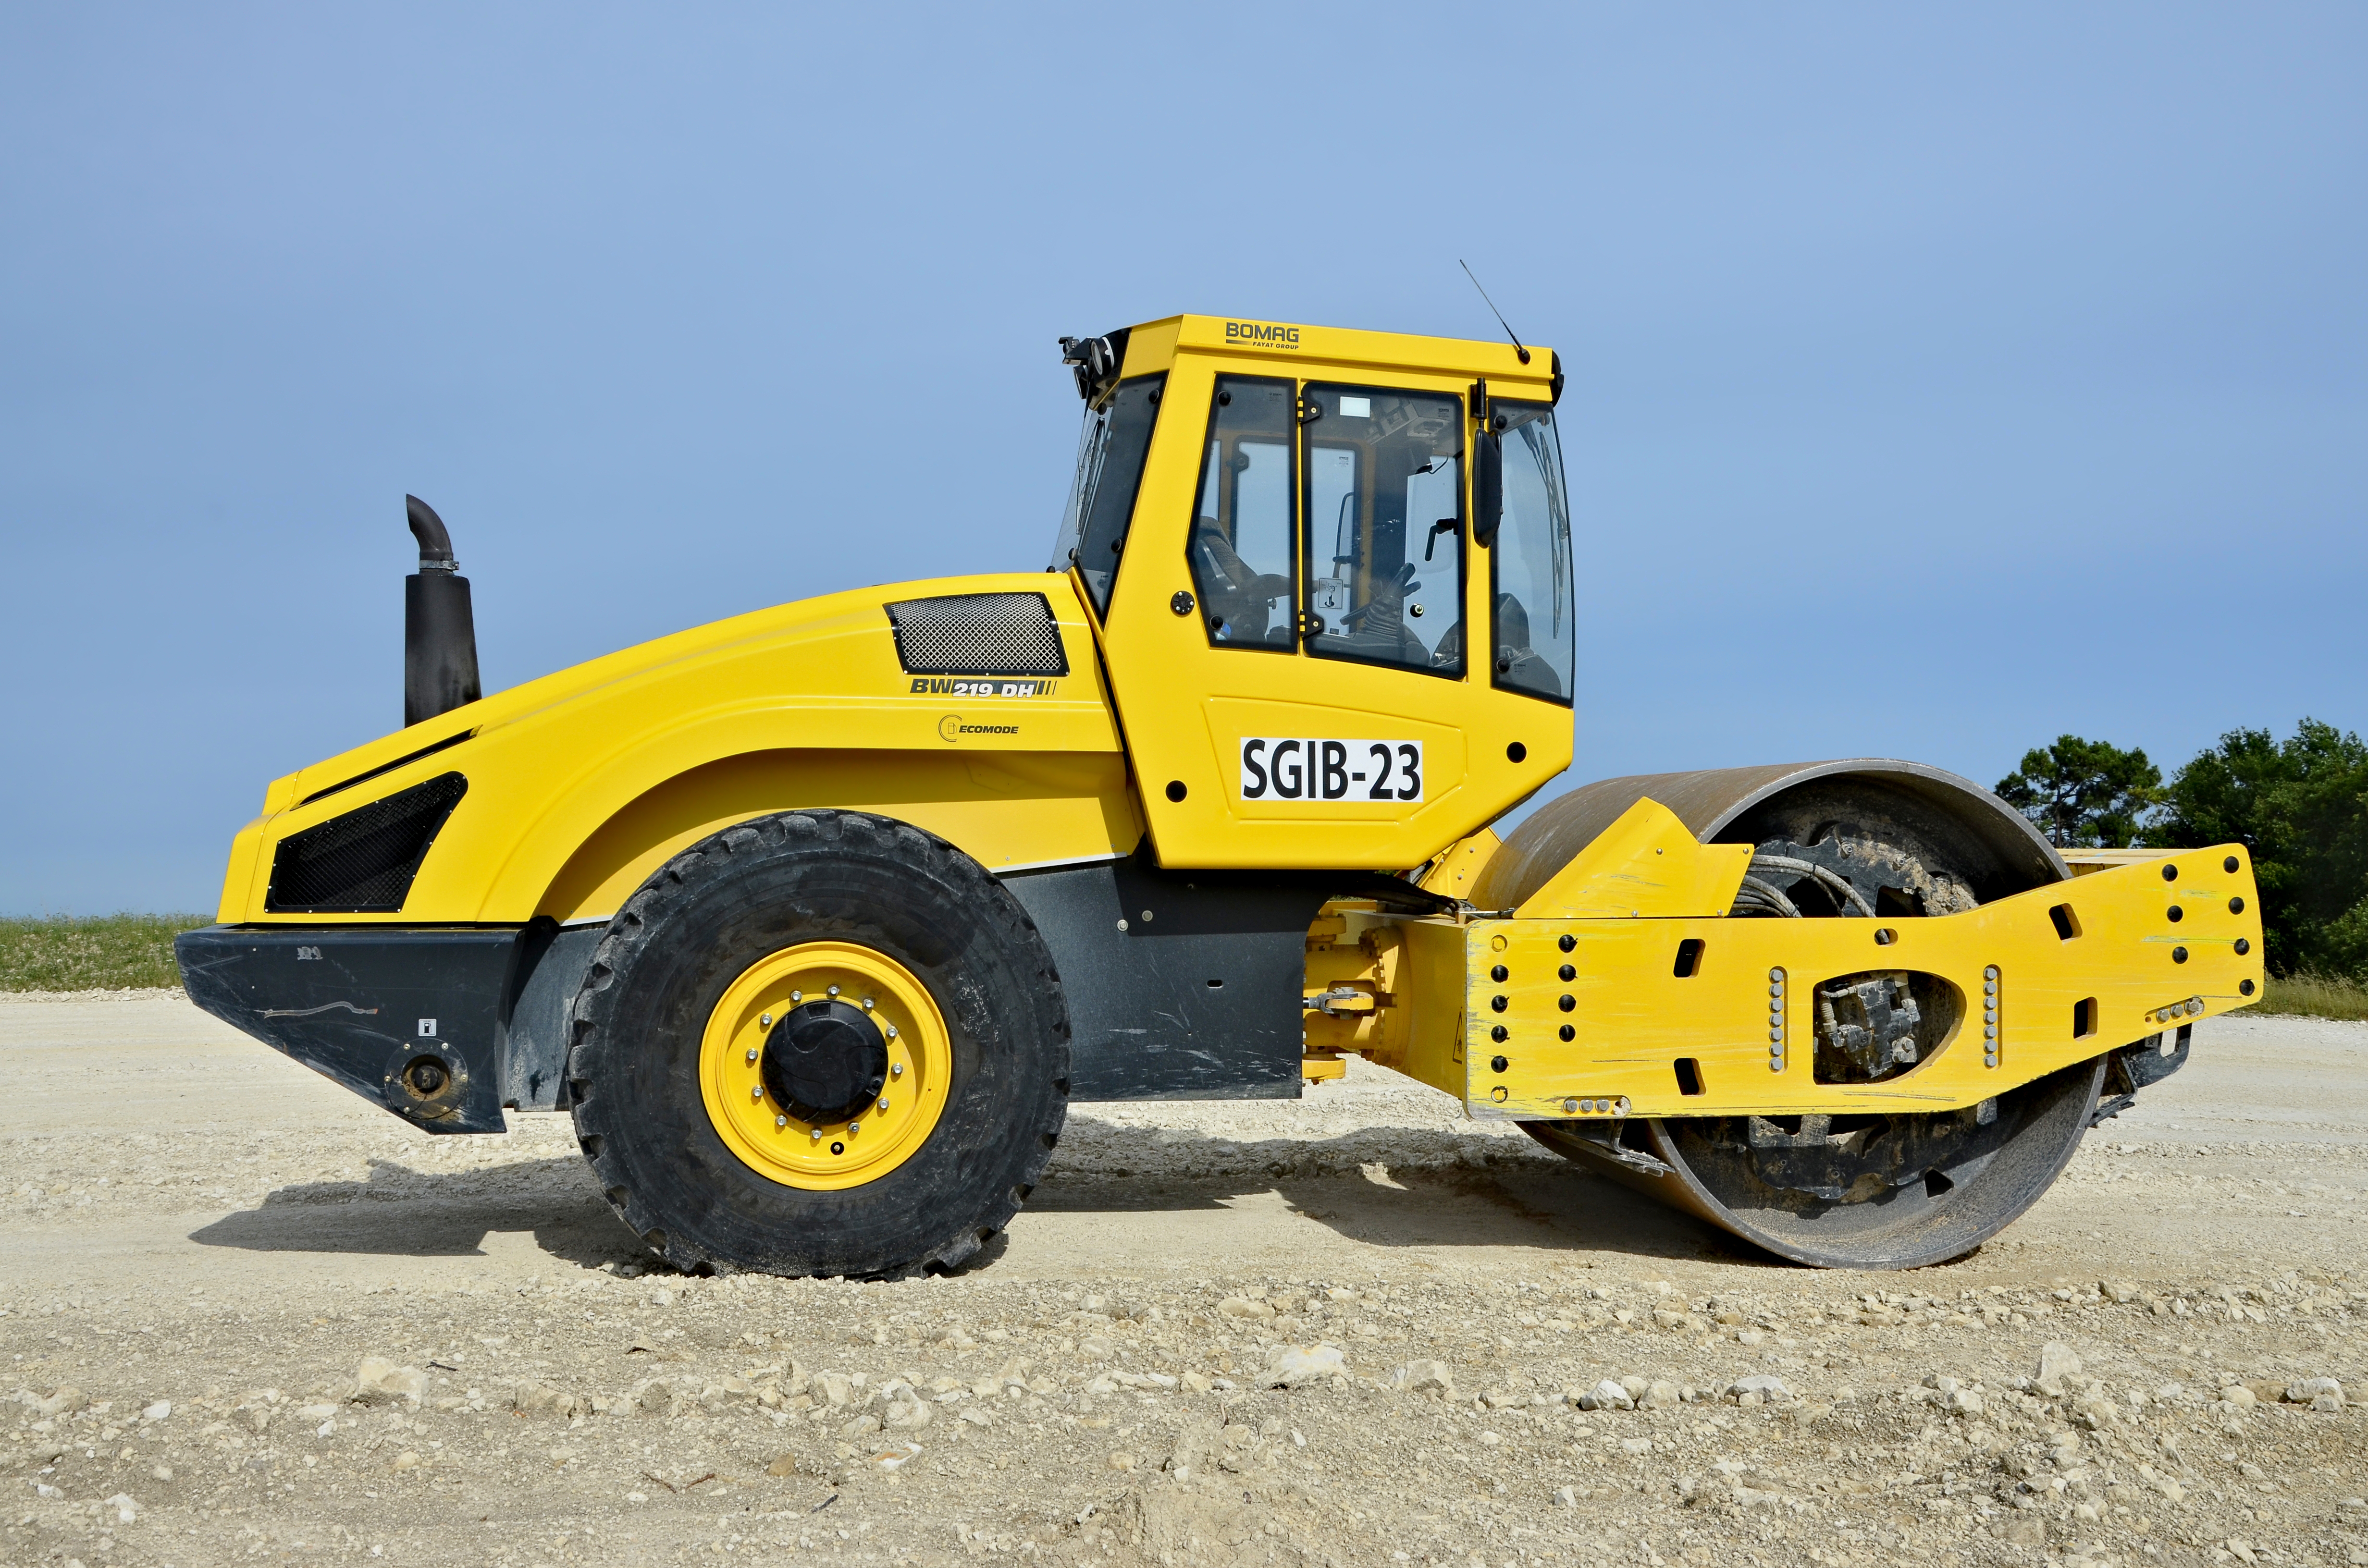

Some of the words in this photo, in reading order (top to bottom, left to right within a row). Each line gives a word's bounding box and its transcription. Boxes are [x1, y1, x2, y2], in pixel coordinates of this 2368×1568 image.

[1226, 322, 1299, 343] BOMAG
[959, 725, 1019, 734] ECOMODE
[1243, 739, 1420, 800] SGIB-23
